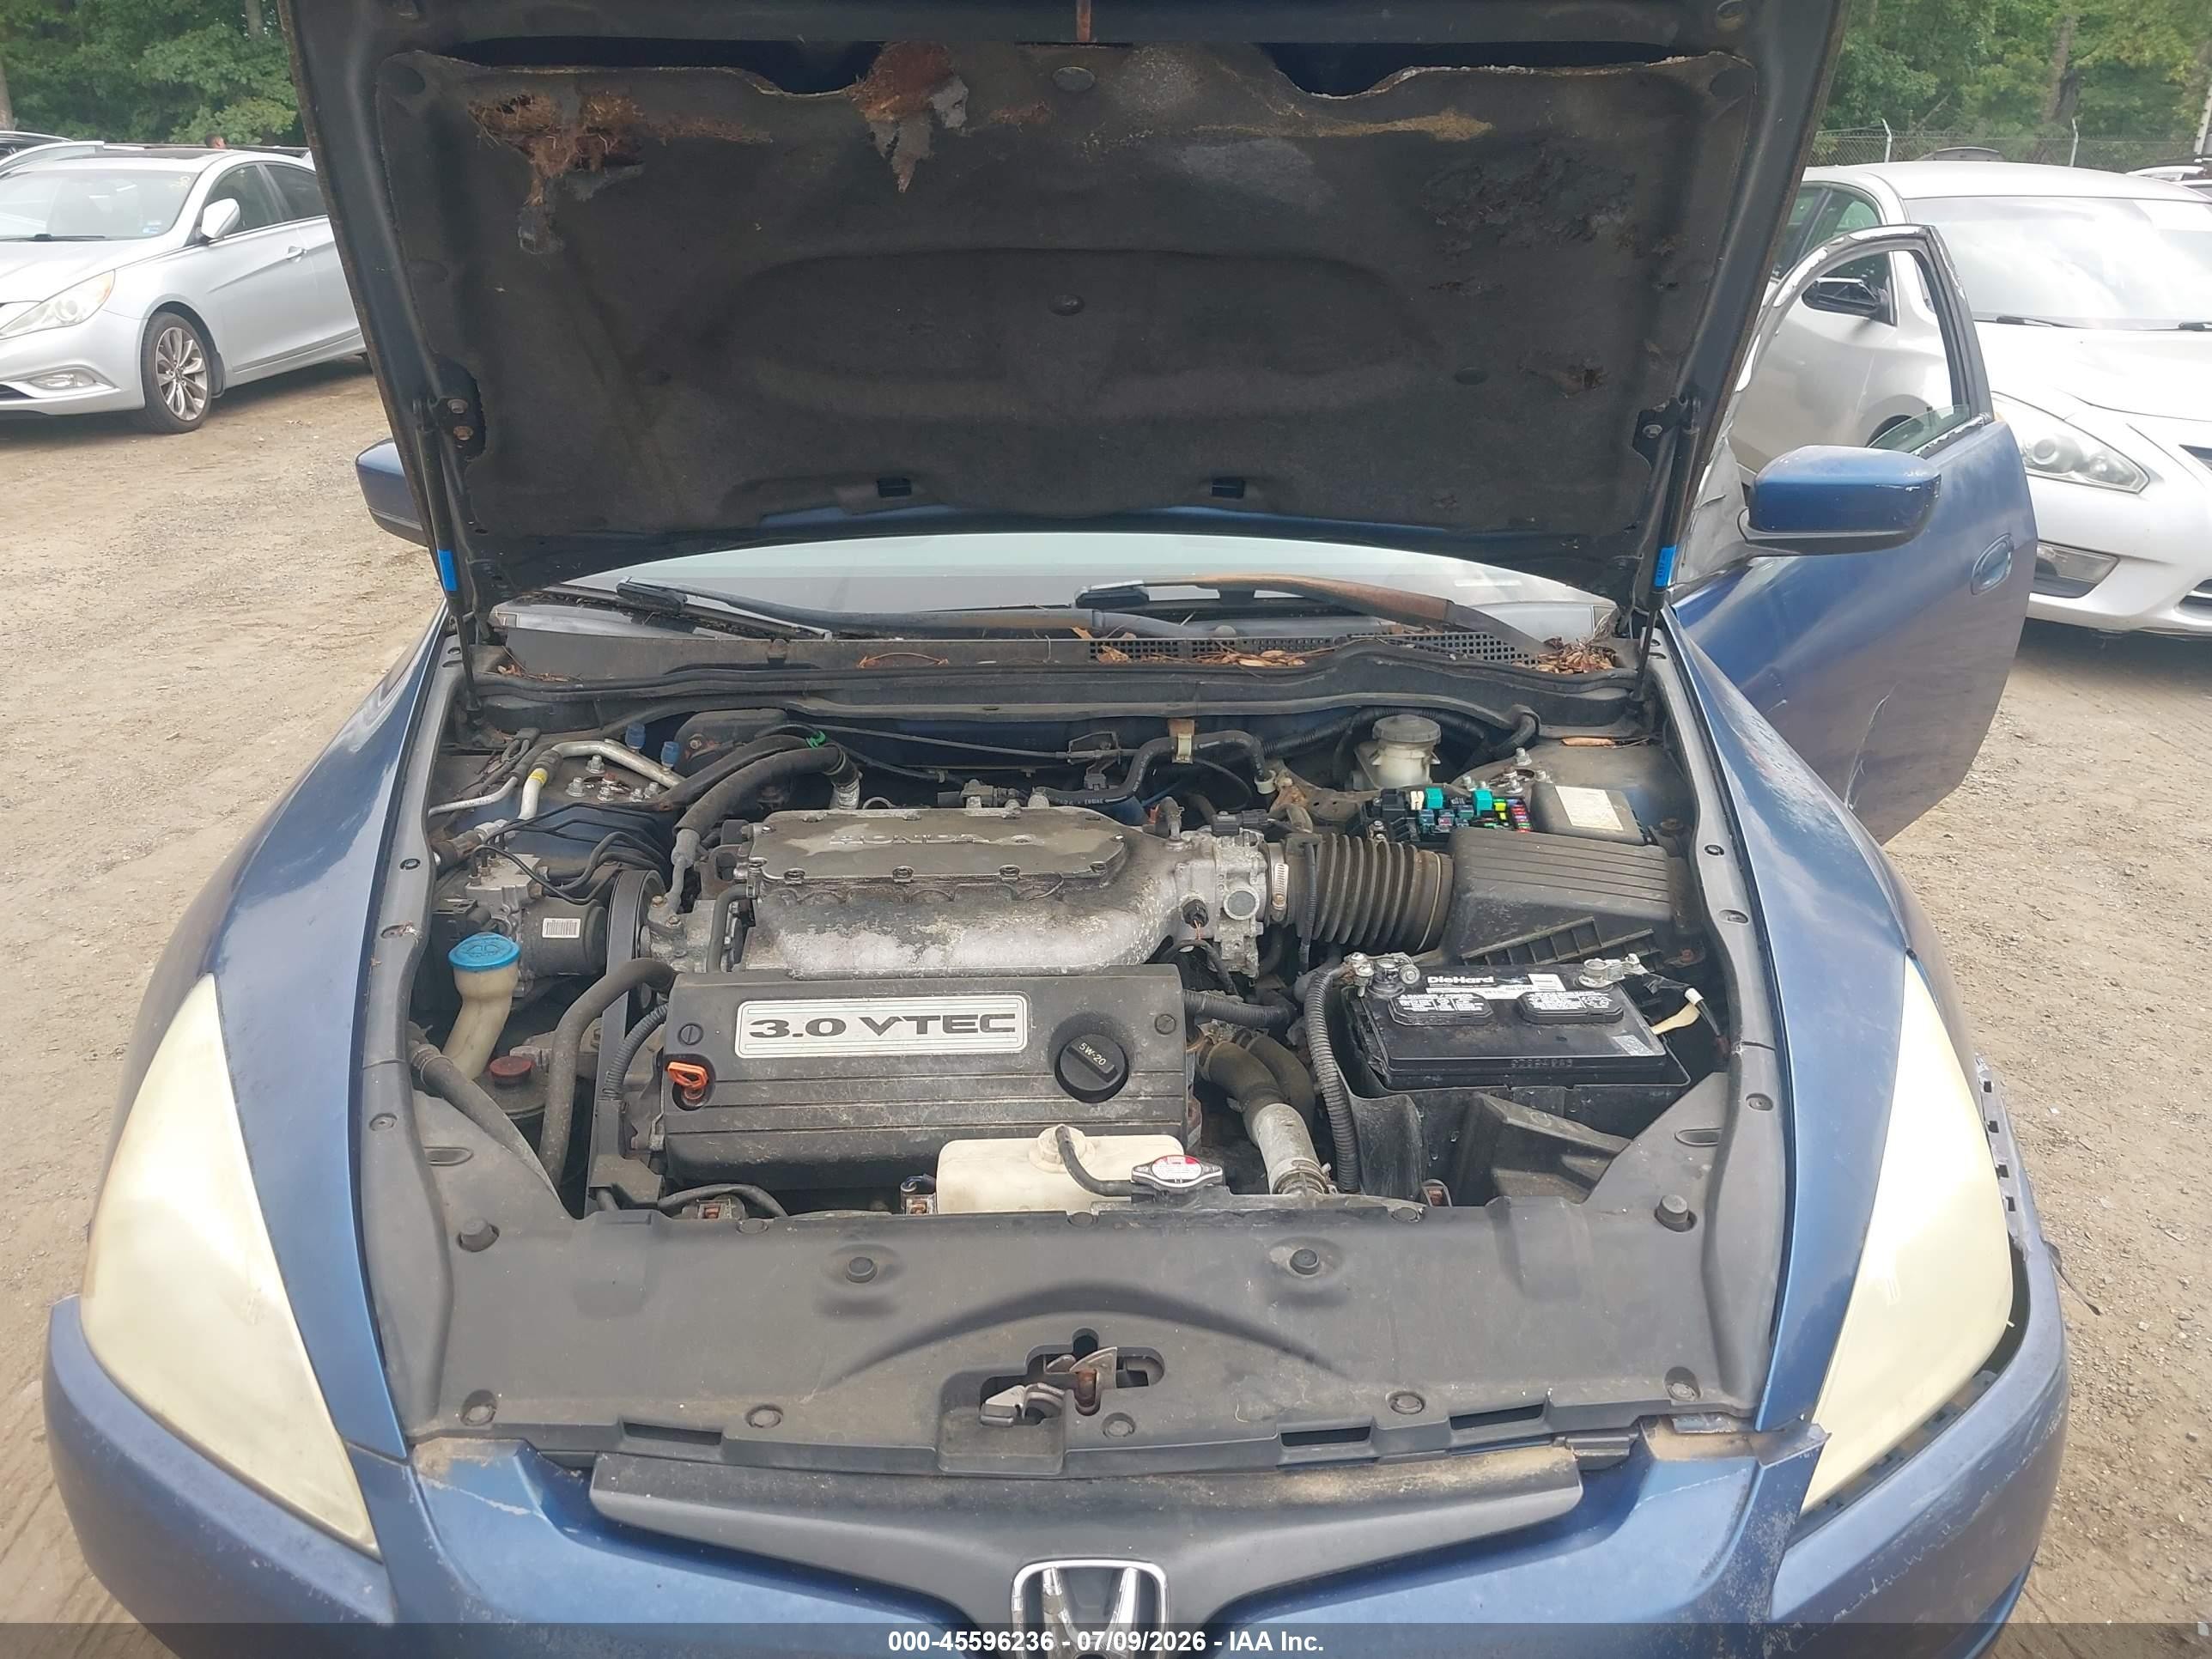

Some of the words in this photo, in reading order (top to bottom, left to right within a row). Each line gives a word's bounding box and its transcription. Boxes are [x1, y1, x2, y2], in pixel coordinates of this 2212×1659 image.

[749, 1018, 847, 1038] 3.0
[859, 1013, 1016, 1036] VTEC
[1079, 1042, 1107, 1065] 5W-20
